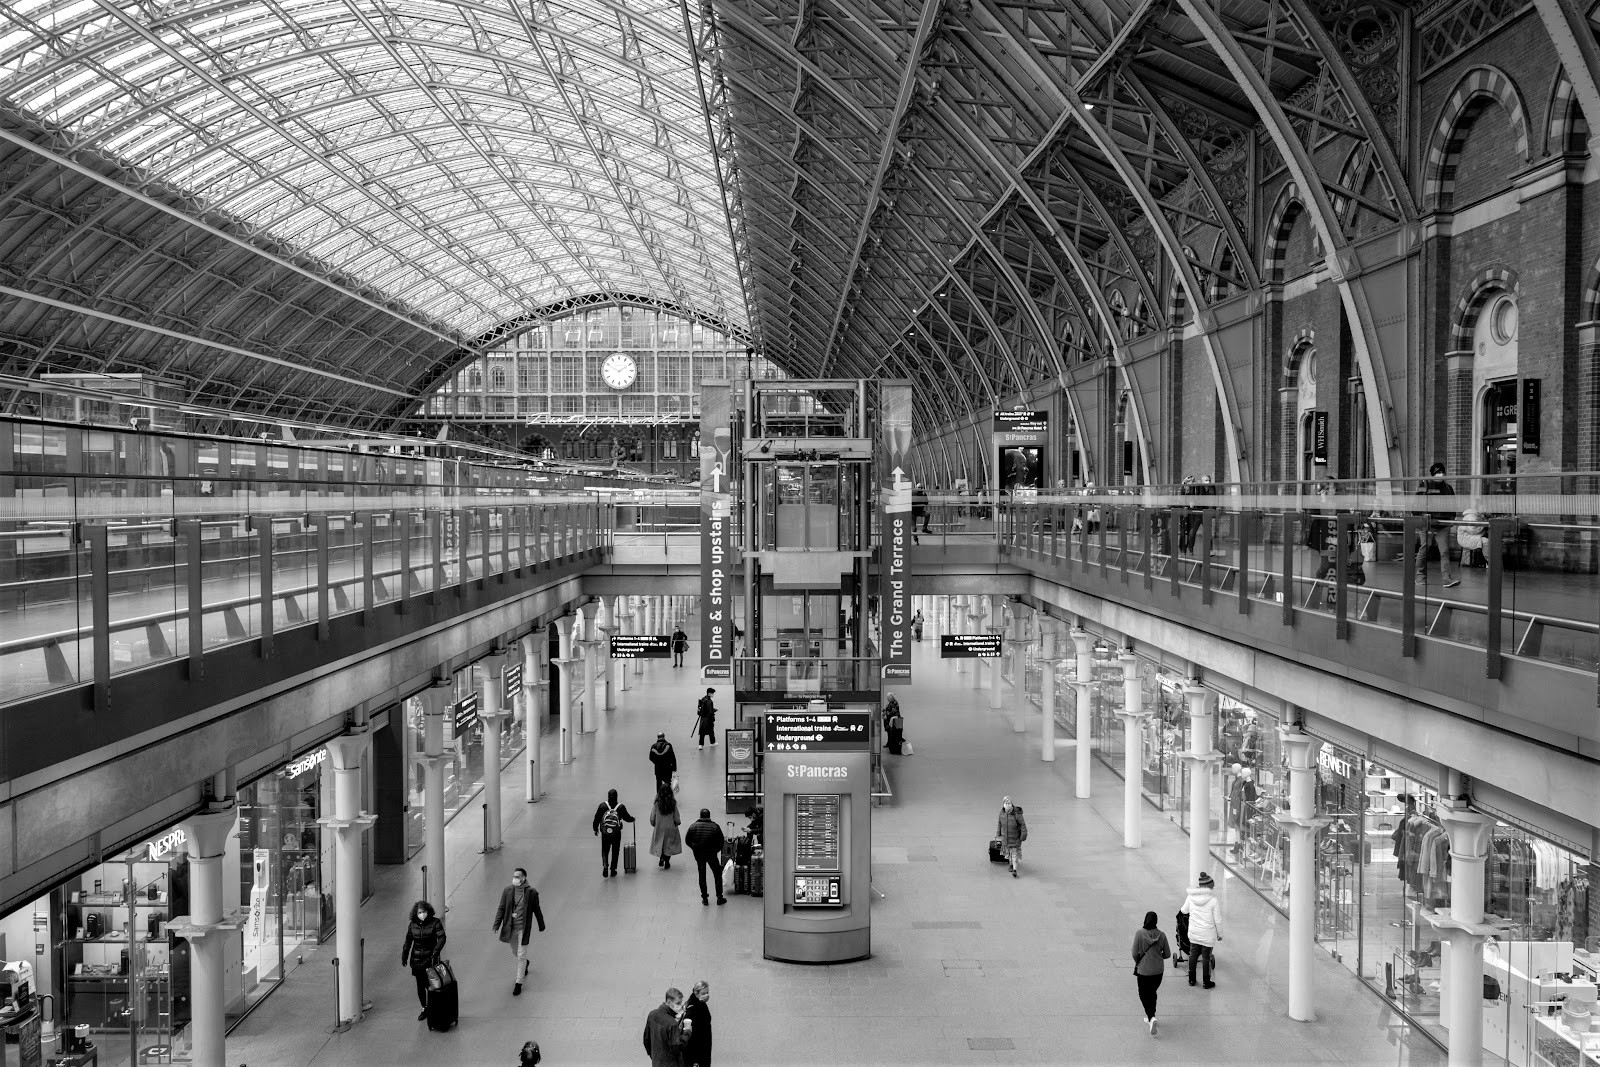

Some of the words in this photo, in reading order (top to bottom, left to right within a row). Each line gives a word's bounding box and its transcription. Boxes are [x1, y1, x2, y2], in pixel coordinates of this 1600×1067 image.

[708, 500, 724, 564] upstairs
[890, 518, 903, 576] Terrace
[708, 568, 724, 605] shop
[890, 580, 903, 625] Grand
[709, 609, 723, 621] &
[709, 625, 723, 659] Dine
[890, 630, 903, 658] The
[776, 734, 814, 742] Underground
[1320, 751, 1350, 778] BENNETT
